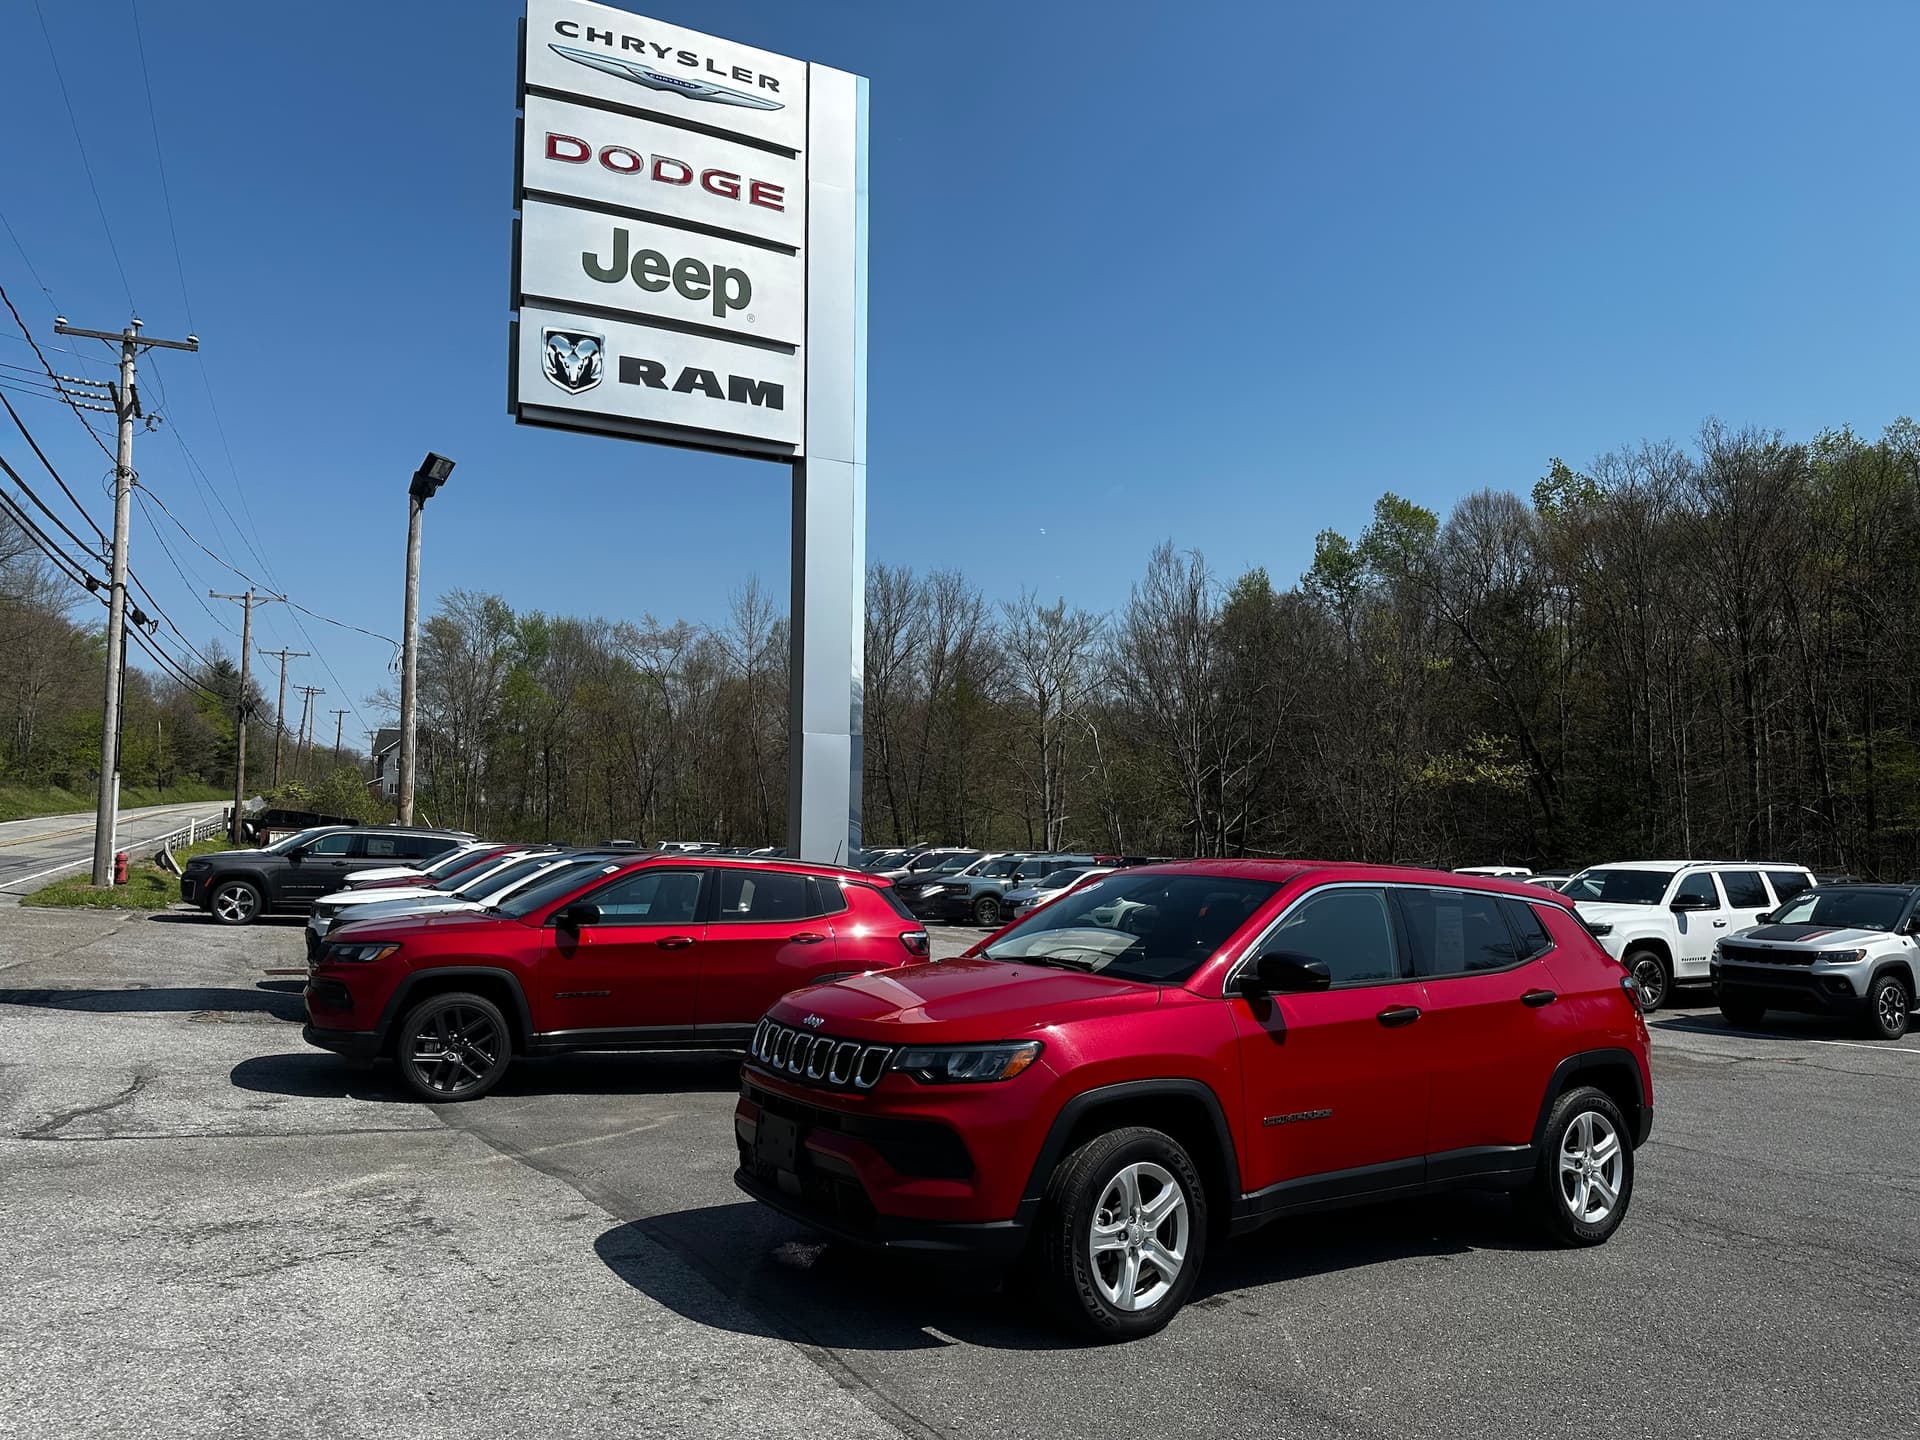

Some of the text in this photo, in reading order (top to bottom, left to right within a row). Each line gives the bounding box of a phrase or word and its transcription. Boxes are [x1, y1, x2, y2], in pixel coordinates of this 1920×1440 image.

[554, 20, 781, 93] CHRYSLER
[545, 132, 785, 213] DODGE
[582, 227, 752, 318] Jeep
[618, 356, 784, 411] RAM
